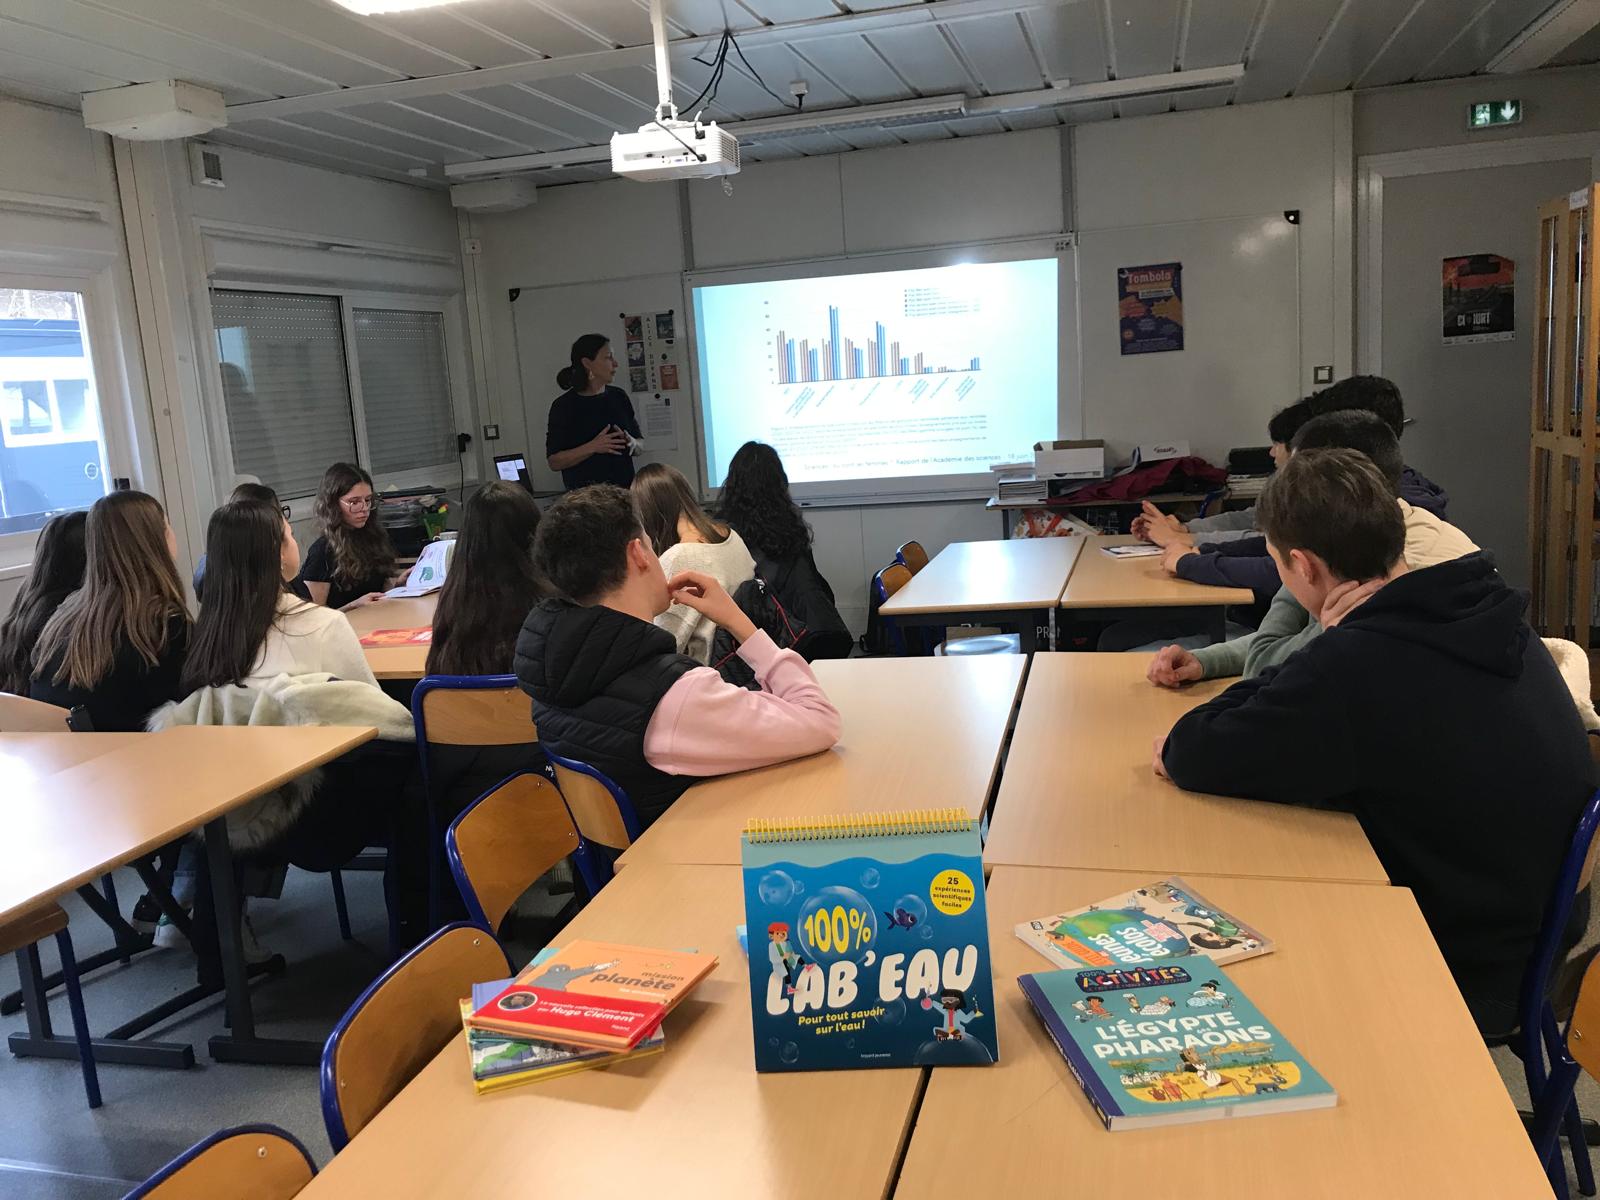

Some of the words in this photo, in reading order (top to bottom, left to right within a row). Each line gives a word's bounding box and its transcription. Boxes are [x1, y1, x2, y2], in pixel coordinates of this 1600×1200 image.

[1128, 270, 1172, 284] Tombola
[896, 457, 920, 466] Rapport
[964, 454, 975, 462] des
[947, 876, 959, 885] 25
[934, 886, 971, 894] expériences
[932, 893, 972, 902] scientifiques
[803, 905, 872, 954] 100%
[589, 972, 677, 991] planète
[641, 971, 685, 982] mission
[766, 944, 978, 1015] LAB'EAU
[550, 1006, 582, 1017] Hugo
[798, 1014, 824, 1026] Pour
[826, 1012, 849, 1022] tout
[851, 1007, 886, 1020] savoir
[815, 1024, 834, 1035] sur
[1096, 1011, 1241, 1041] L'ÉGYPTE
[1092, 1025, 1272, 1059] PHARAONS
